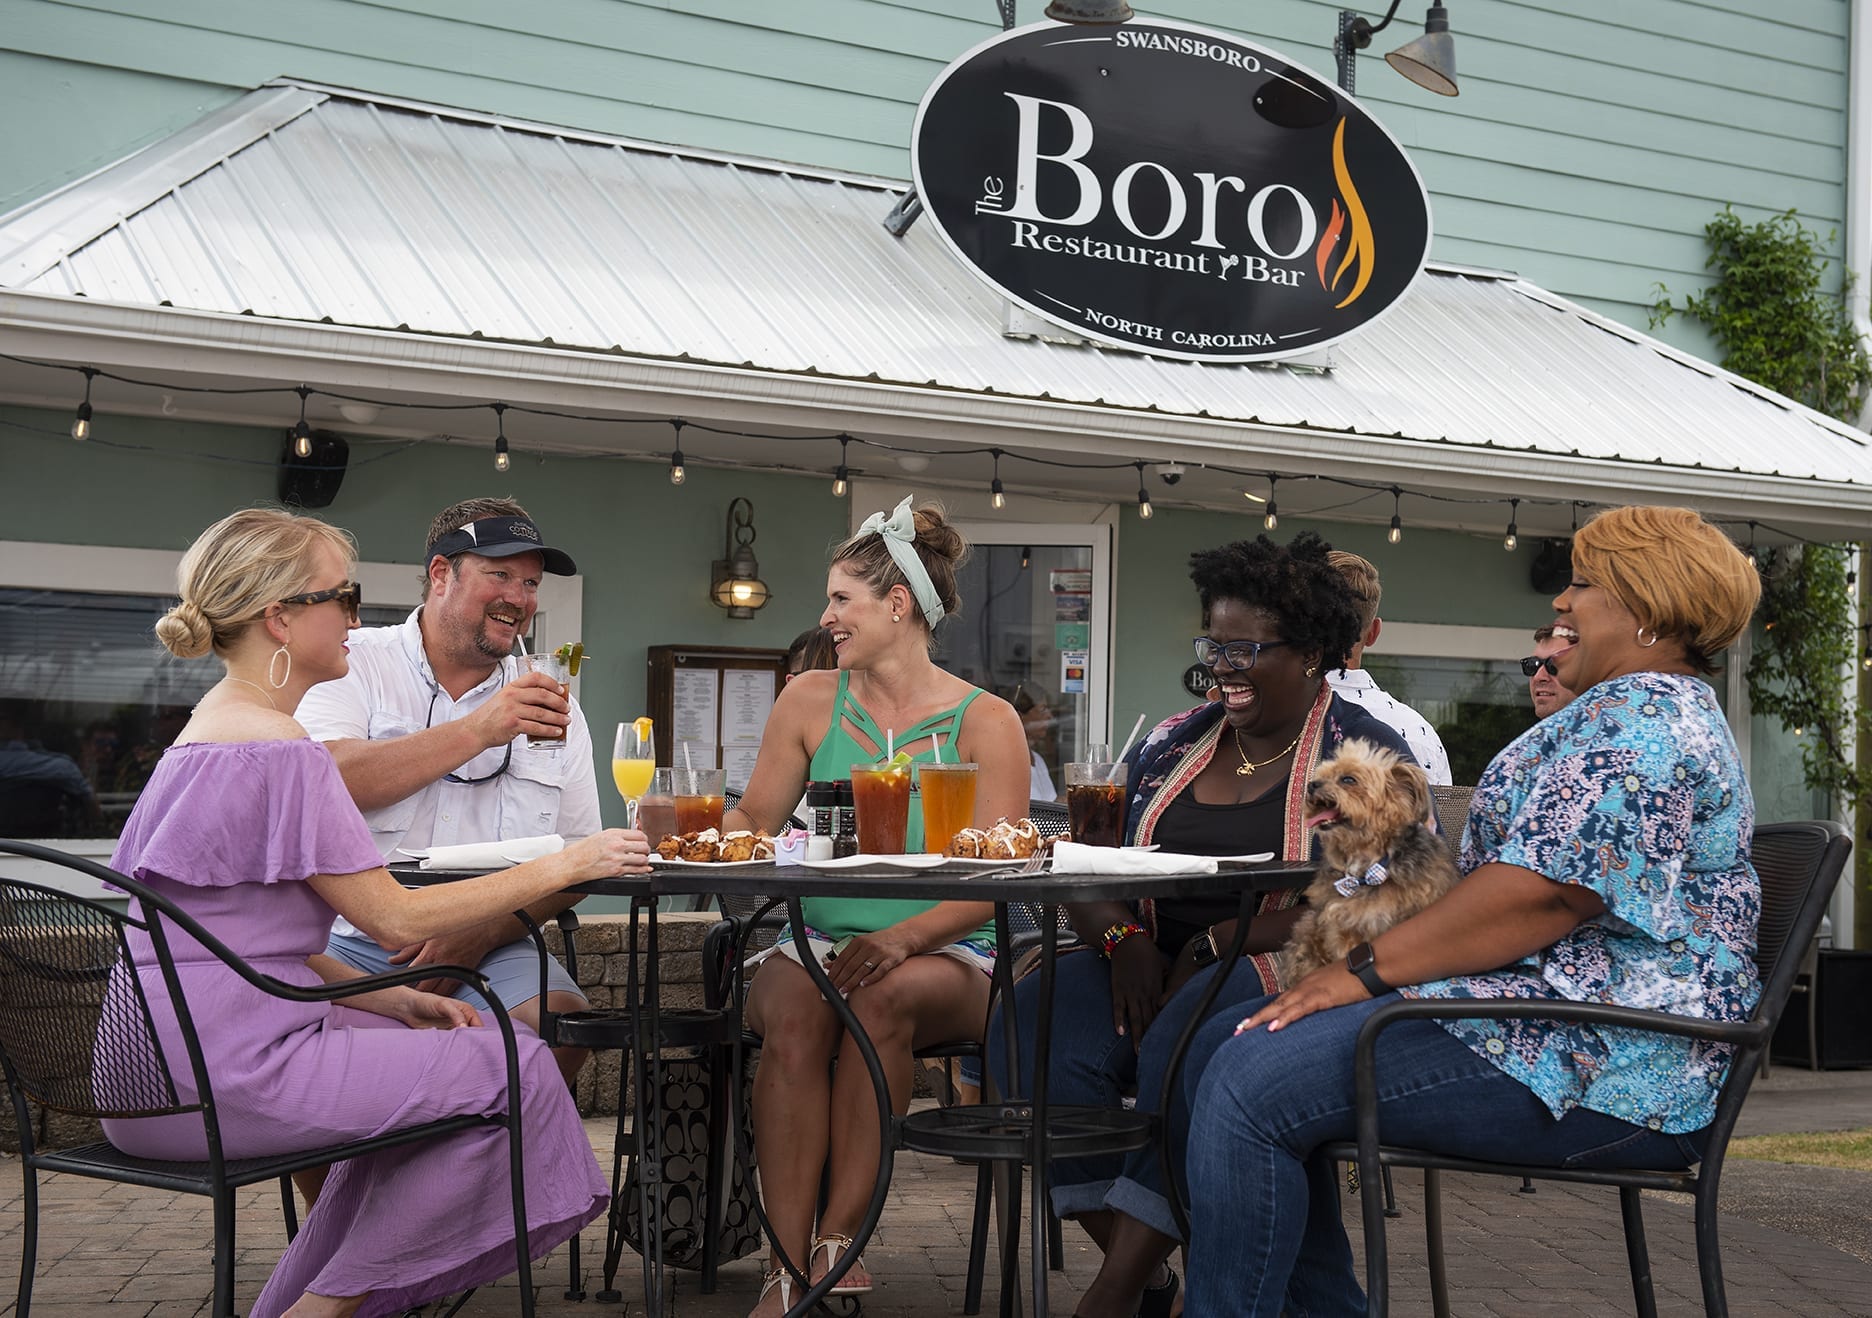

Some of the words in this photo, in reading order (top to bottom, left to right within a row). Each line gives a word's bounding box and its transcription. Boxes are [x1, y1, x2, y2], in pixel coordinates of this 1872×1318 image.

[1116, 30, 1261, 73] SWANSBORO
[975, 175, 1004, 215] The
[1000, 91, 1318, 260] Boro
[1010, 220, 1210, 274] Restaurant
[1243, 254, 1306, 288] Bar
[1084, 307, 1164, 341] NORTH
[1171, 330, 1277, 349] CAROLINA
